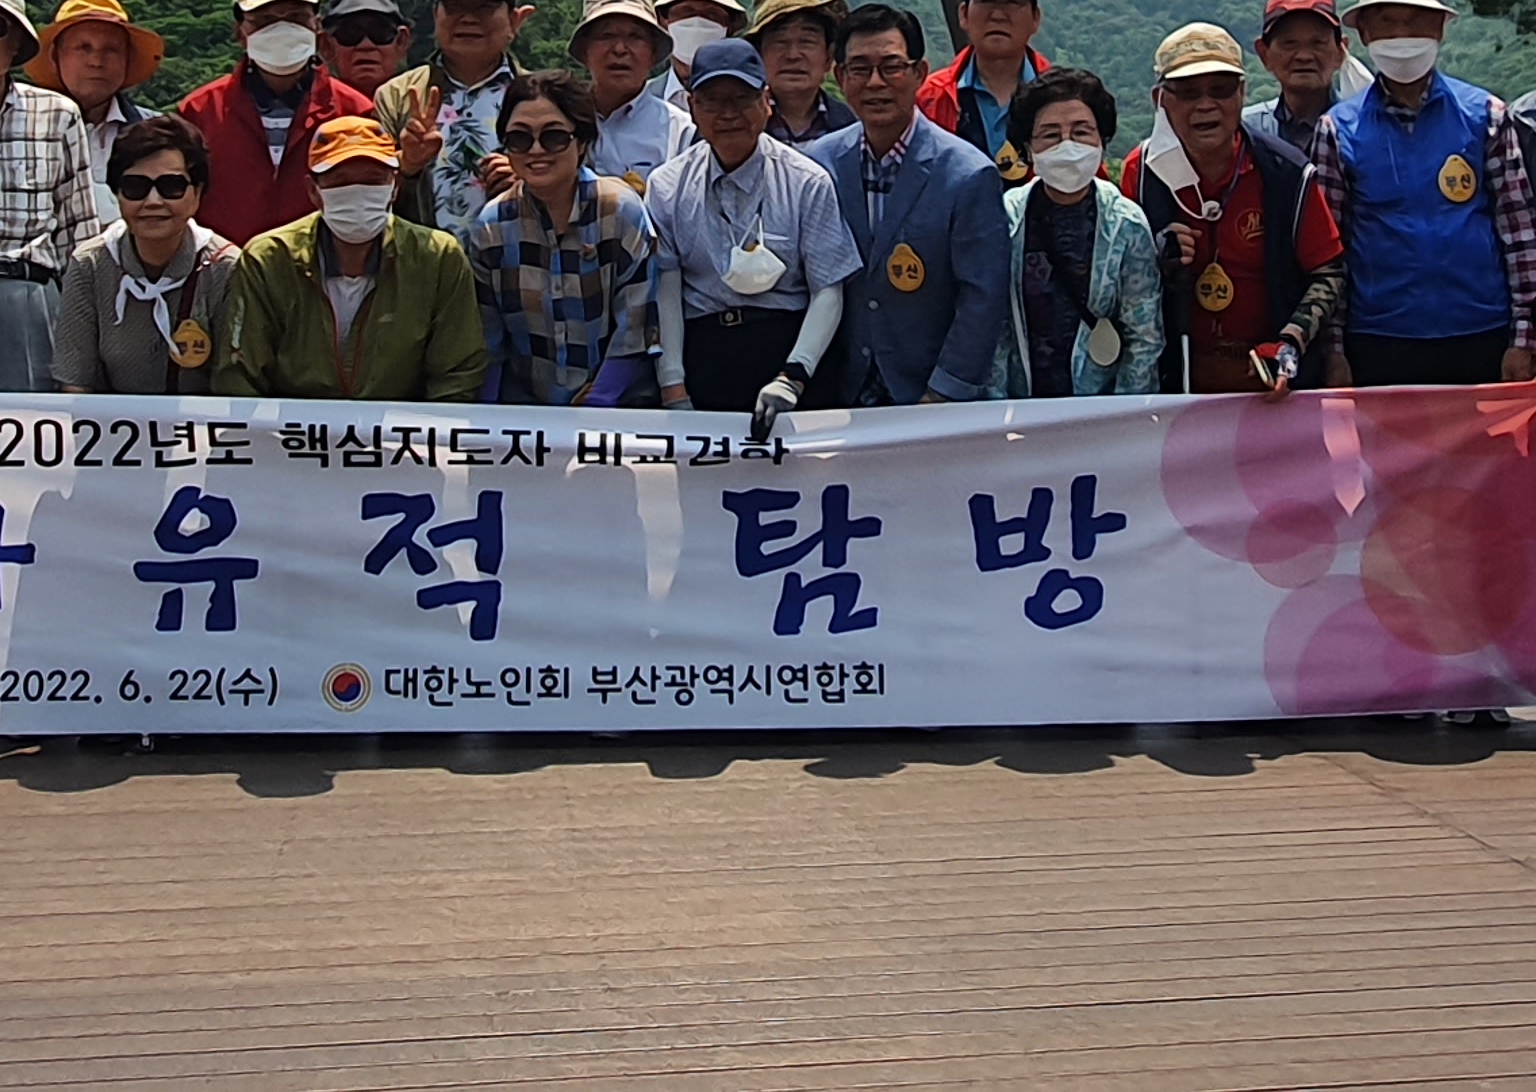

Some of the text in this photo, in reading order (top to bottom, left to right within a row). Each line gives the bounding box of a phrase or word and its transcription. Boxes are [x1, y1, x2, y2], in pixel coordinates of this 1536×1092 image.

[278, 422, 552, 469] 핵심지도자
[168, 666, 278, 707] 22(수)
[384, 660, 885, 707] 대한노인회 부산광역시연합회
